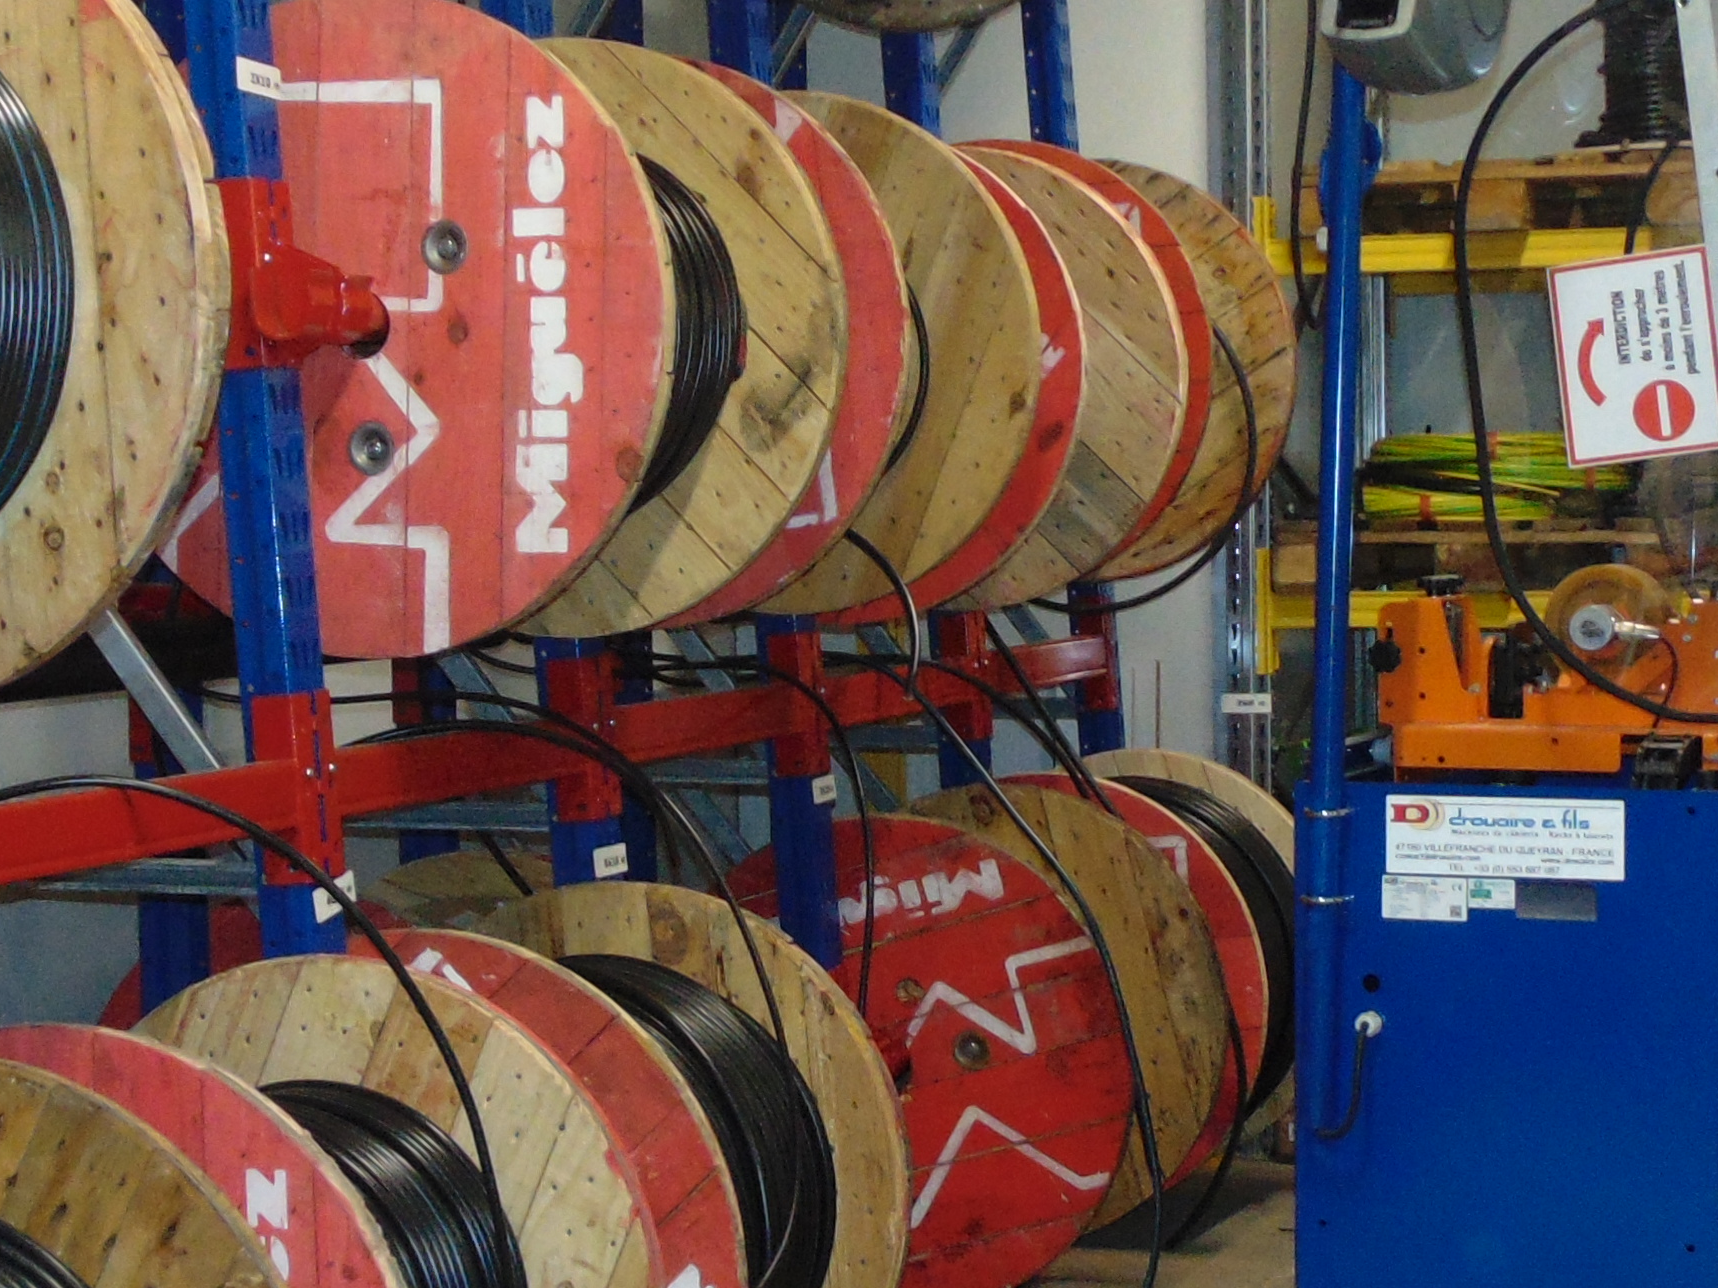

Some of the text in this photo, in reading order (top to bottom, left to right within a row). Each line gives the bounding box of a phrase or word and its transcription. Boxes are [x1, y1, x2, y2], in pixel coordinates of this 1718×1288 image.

[1610, 290, 1631, 364] INTERDICTION
[1658, 317, 1670, 329] de
[1640, 349, 1652, 361] de
[1660, 332, 1674, 361] moins
[1682, 334, 1701, 374] pendant
[1448, 807, 1537, 828] drouaire
[1561, 808, 1591, 830] fils
[1424, 842, 1495, 853] VILLEFRANCHE
[1498, 845, 1513, 854] DU
[1571, 847, 1615, 857] FRANCE
